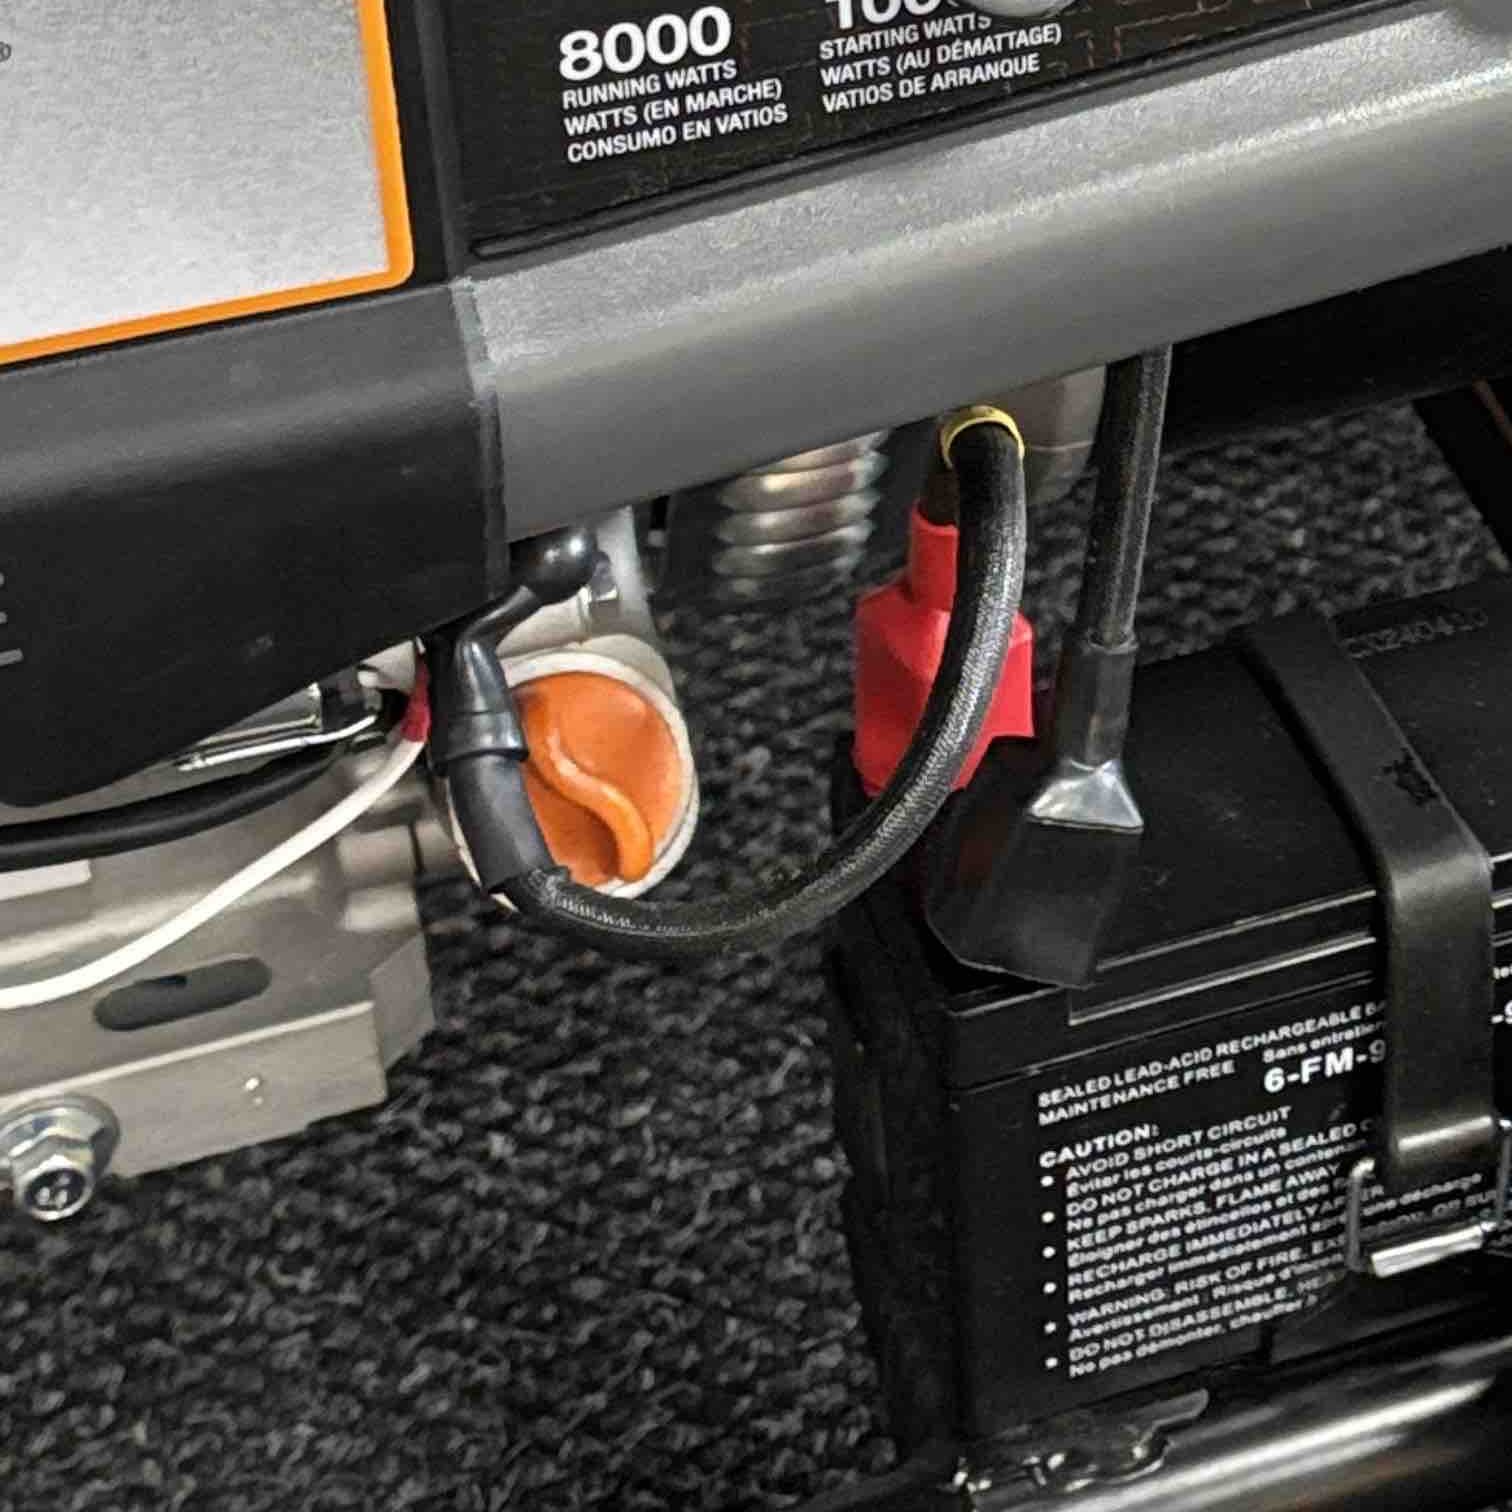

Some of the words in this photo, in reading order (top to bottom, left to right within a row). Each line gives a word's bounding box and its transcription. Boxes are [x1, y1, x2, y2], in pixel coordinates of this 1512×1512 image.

[558, 5, 732, 81] 8000
[820, 23, 920, 60] STARTING
[924, 12, 992, 34] WATTS
[820, 55, 893, 88] WATTS
[896, 48, 930, 76] (AU
[936, 22, 1062, 63] DÉMATTAGE)
[563, 73, 661, 111] RUNNING
[665, 59, 738, 90] WATTS
[563, 105, 638, 138] WATTS
[644, 99, 684, 128] (EN
[686, 78, 782, 115] MARCHE)
[822, 82, 894, 115] VATIOS
[899, 75, 926, 98] DE
[930, 52, 1040, 92] ARRANQUE
[567, 127, 678, 164] CONSUMO
[682, 120, 712, 141] EN
[715, 105, 788, 133] VATIOS
[1038, 1075, 1111, 1109] SEALED
[1114, 1047, 1212, 1088] LEAD-ACID
[1216, 1005, 1361, 1060] RECHARGEABLE
[1038, 1073, 1180, 1127] MAINTENANCE
[1183, 1058, 1236, 1087] FREE
[1039, 1124, 1160, 1168] CAUTION:
[1065, 1150, 1129, 1181] AVOID
[1132, 1130, 1203, 1162] SHORT
[1206, 1106, 1291, 1141] CIRCUIT
[1066, 1195, 1097, 1218] DO
[1101, 1182, 1143, 1208] NOT
[1147, 1156, 1233, 1195] CHARGE
[1278, 1121, 1357, 1157] SEALED
[1066, 1223, 1122, 1253] KEEP
[1215, 1179, 1281, 1211] FLAME
[1284, 1162, 1340, 1191] AWAY
[1067, 1242, 1182, 1288] RECHARGE
[1184, 1202, 1318, 1254] IMMEDIATELY
[1173, 1269, 1220, 1297] RISK
[1224, 1260, 1252, 1282] OF
[1069, 1339, 1100, 1362] DO
[1103, 1326, 1144, 1352] NOT
